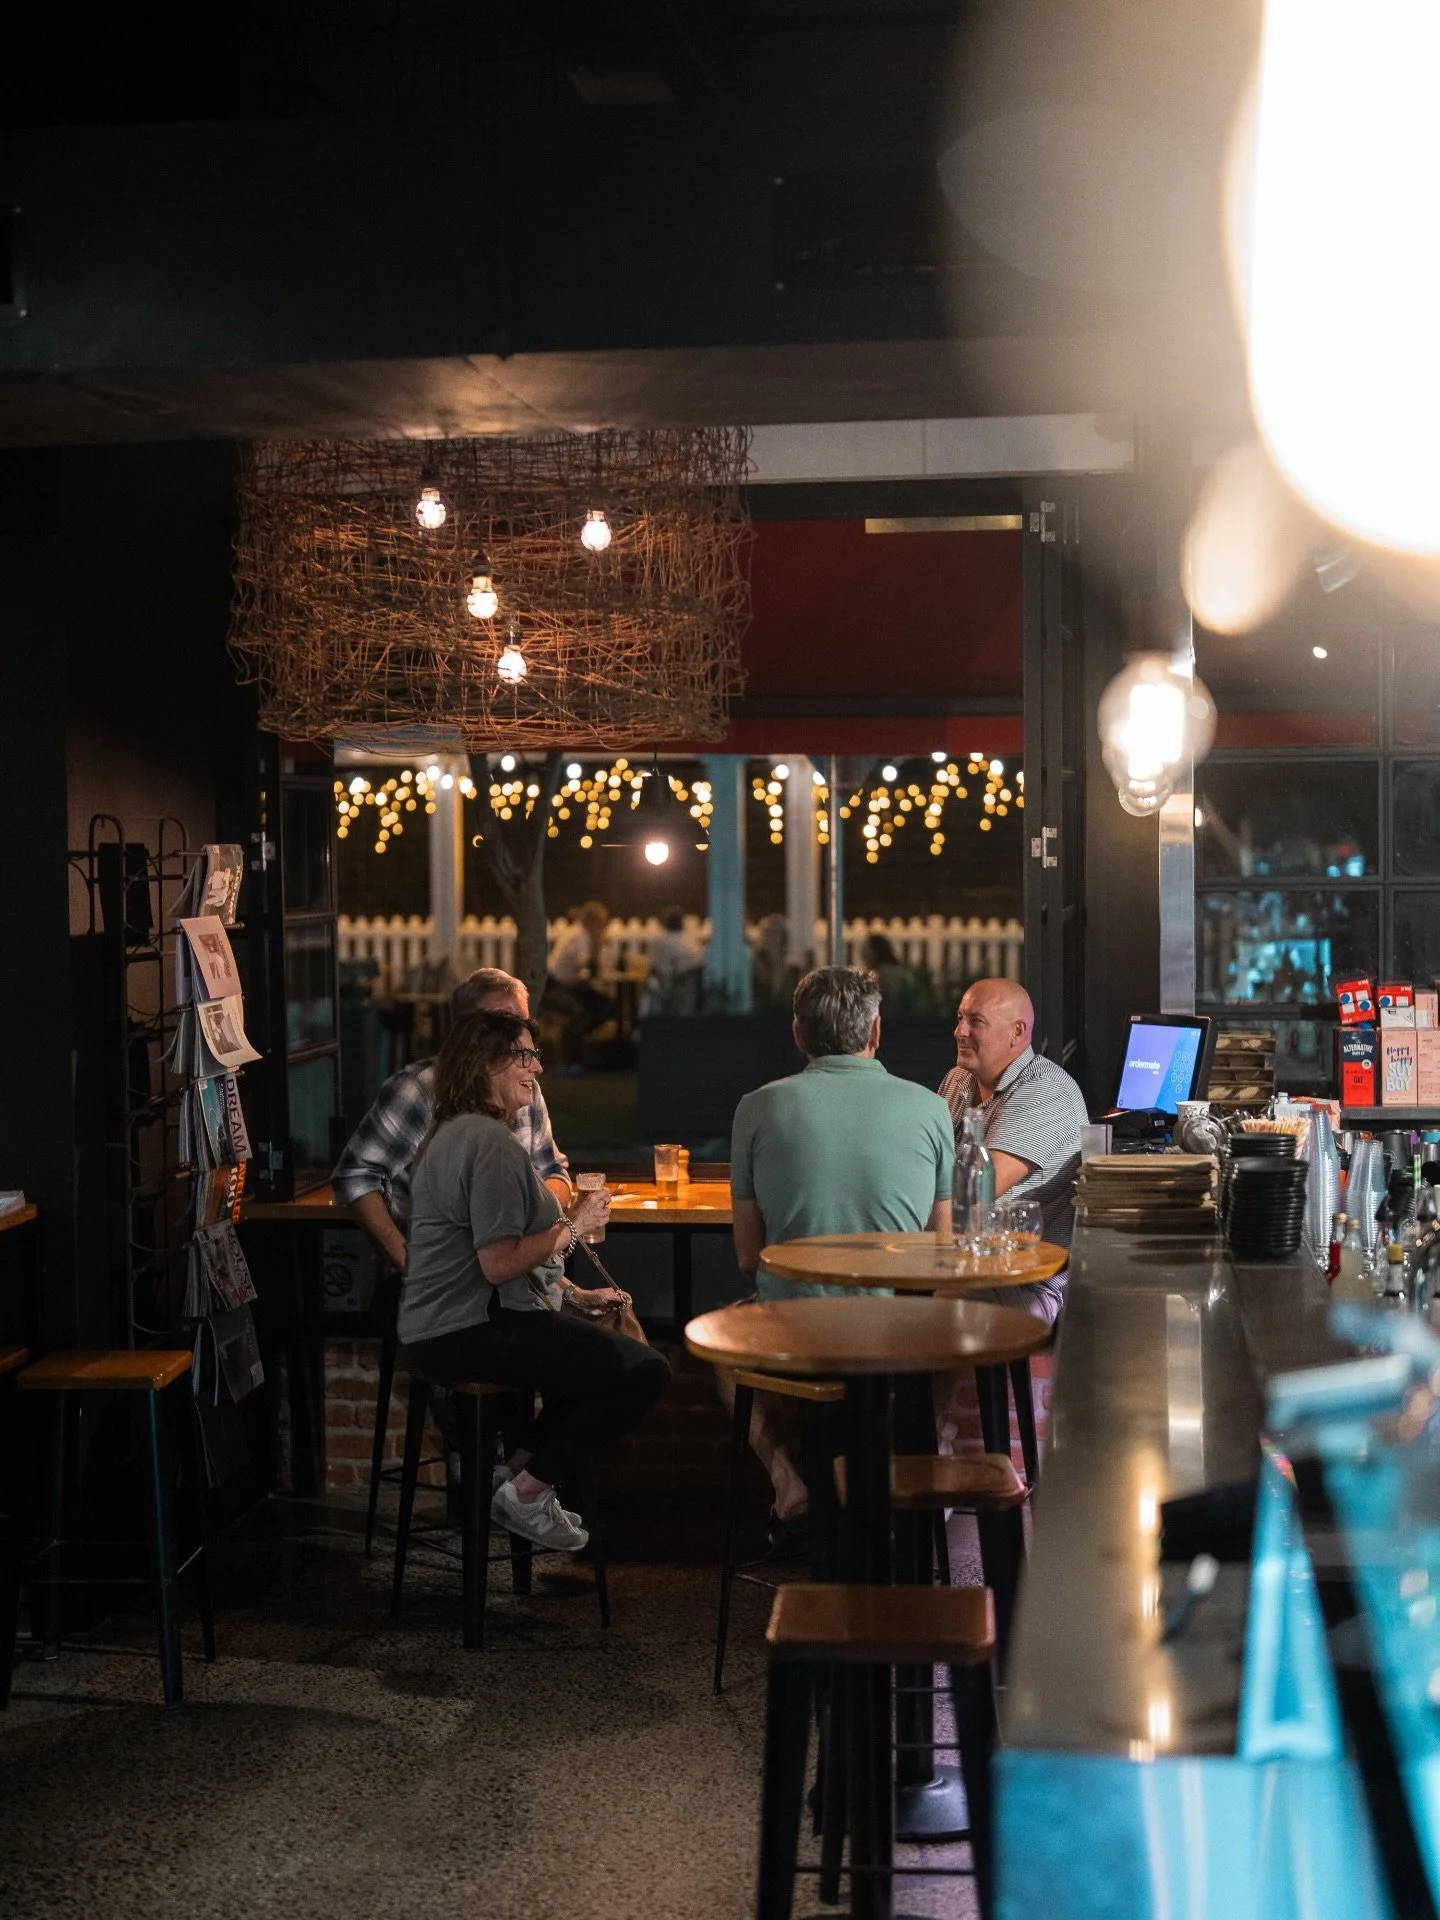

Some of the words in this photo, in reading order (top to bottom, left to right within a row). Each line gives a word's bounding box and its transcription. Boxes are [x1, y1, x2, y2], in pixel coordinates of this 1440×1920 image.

[1343, 1044, 1373, 1053] ALTERNATIVE
[1129, 1059, 1160, 1070] ordermate
[1388, 1062, 1411, 1077] SOY
[1386, 1077, 1412, 1091] BOY
[227, 1079, 247, 1153] DREAM
